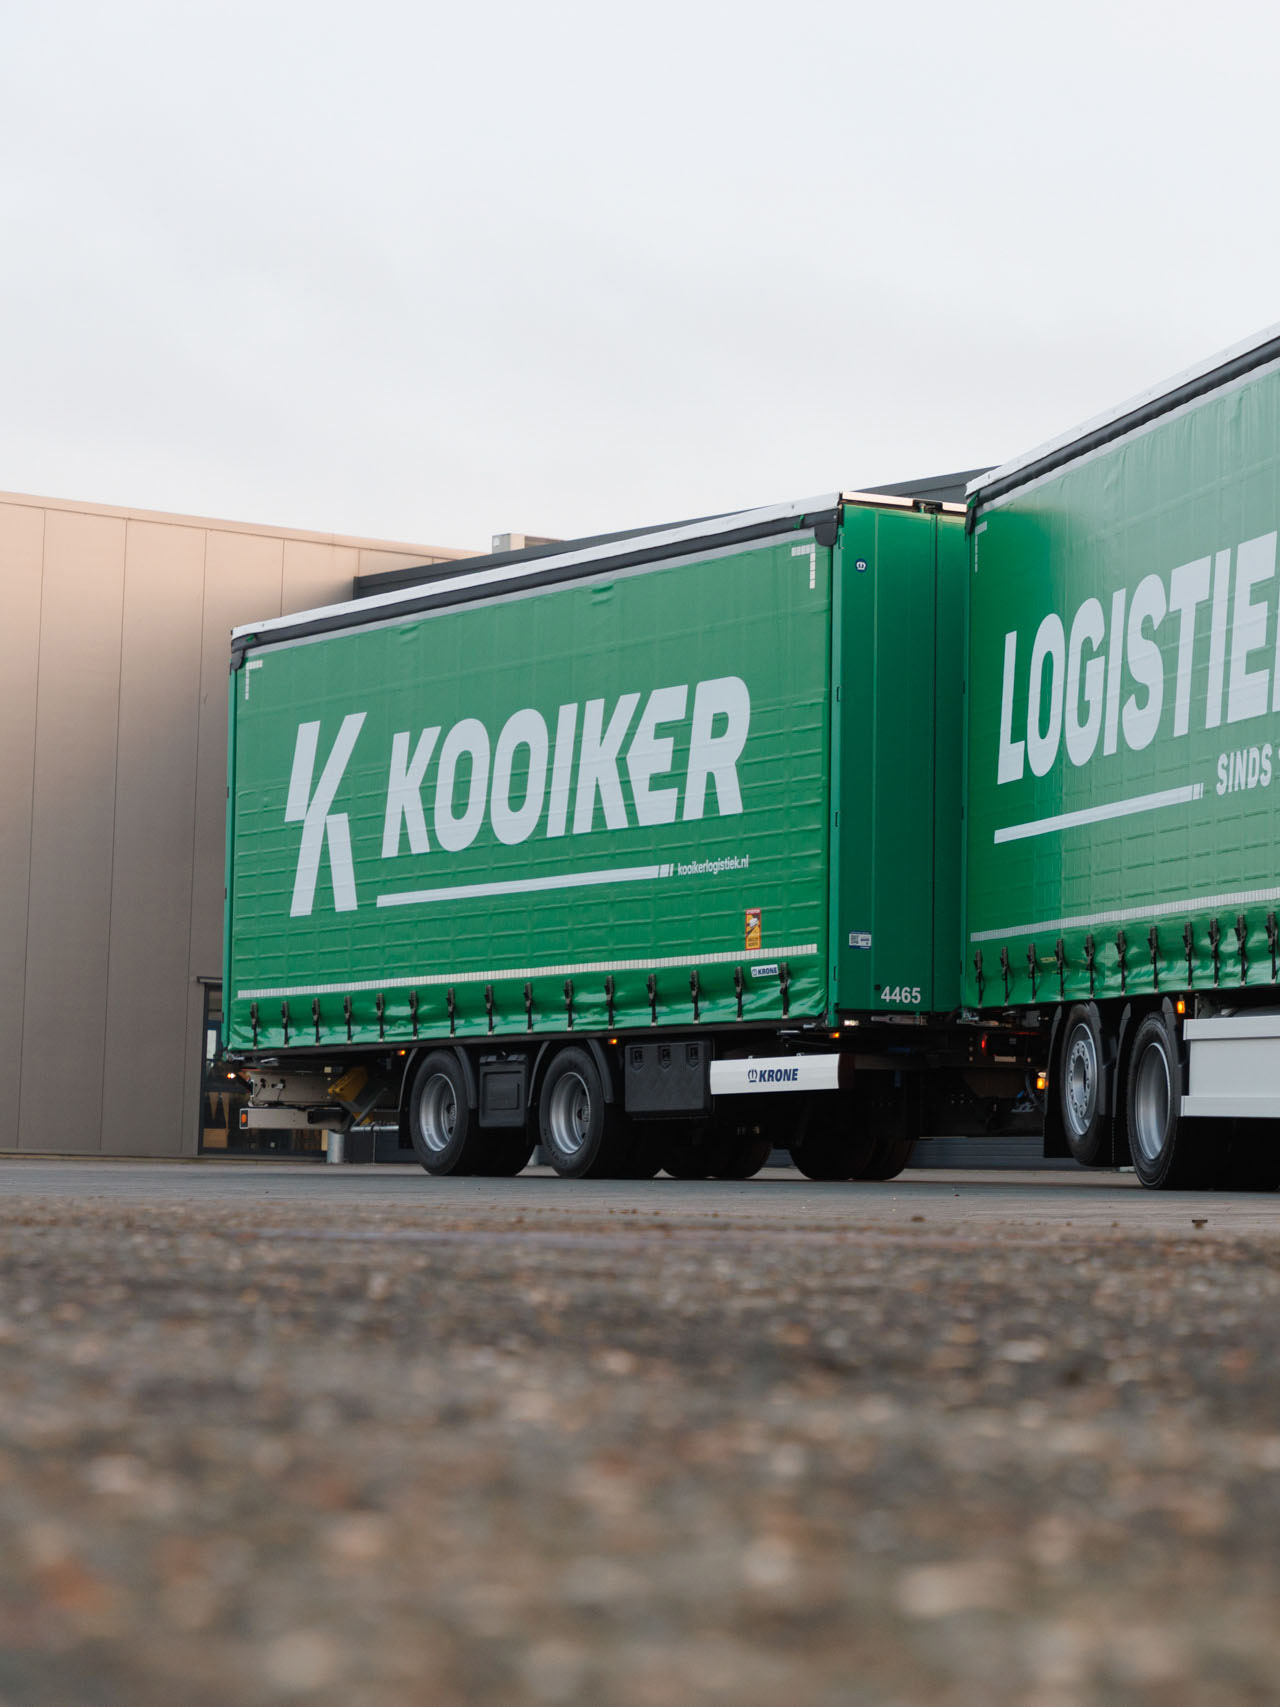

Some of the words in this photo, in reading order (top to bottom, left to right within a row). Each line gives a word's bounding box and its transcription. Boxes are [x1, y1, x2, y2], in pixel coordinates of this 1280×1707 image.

[381, 675, 751, 859] KOOIKER
[1216, 743, 1273, 796] SINDS
[677, 853, 749, 876] kooikerlogistiek.nl
[757, 967, 778, 975] KRONE
[881, 986, 921, 1004] 4465
[758, 1068, 799, 1083] KRONE
